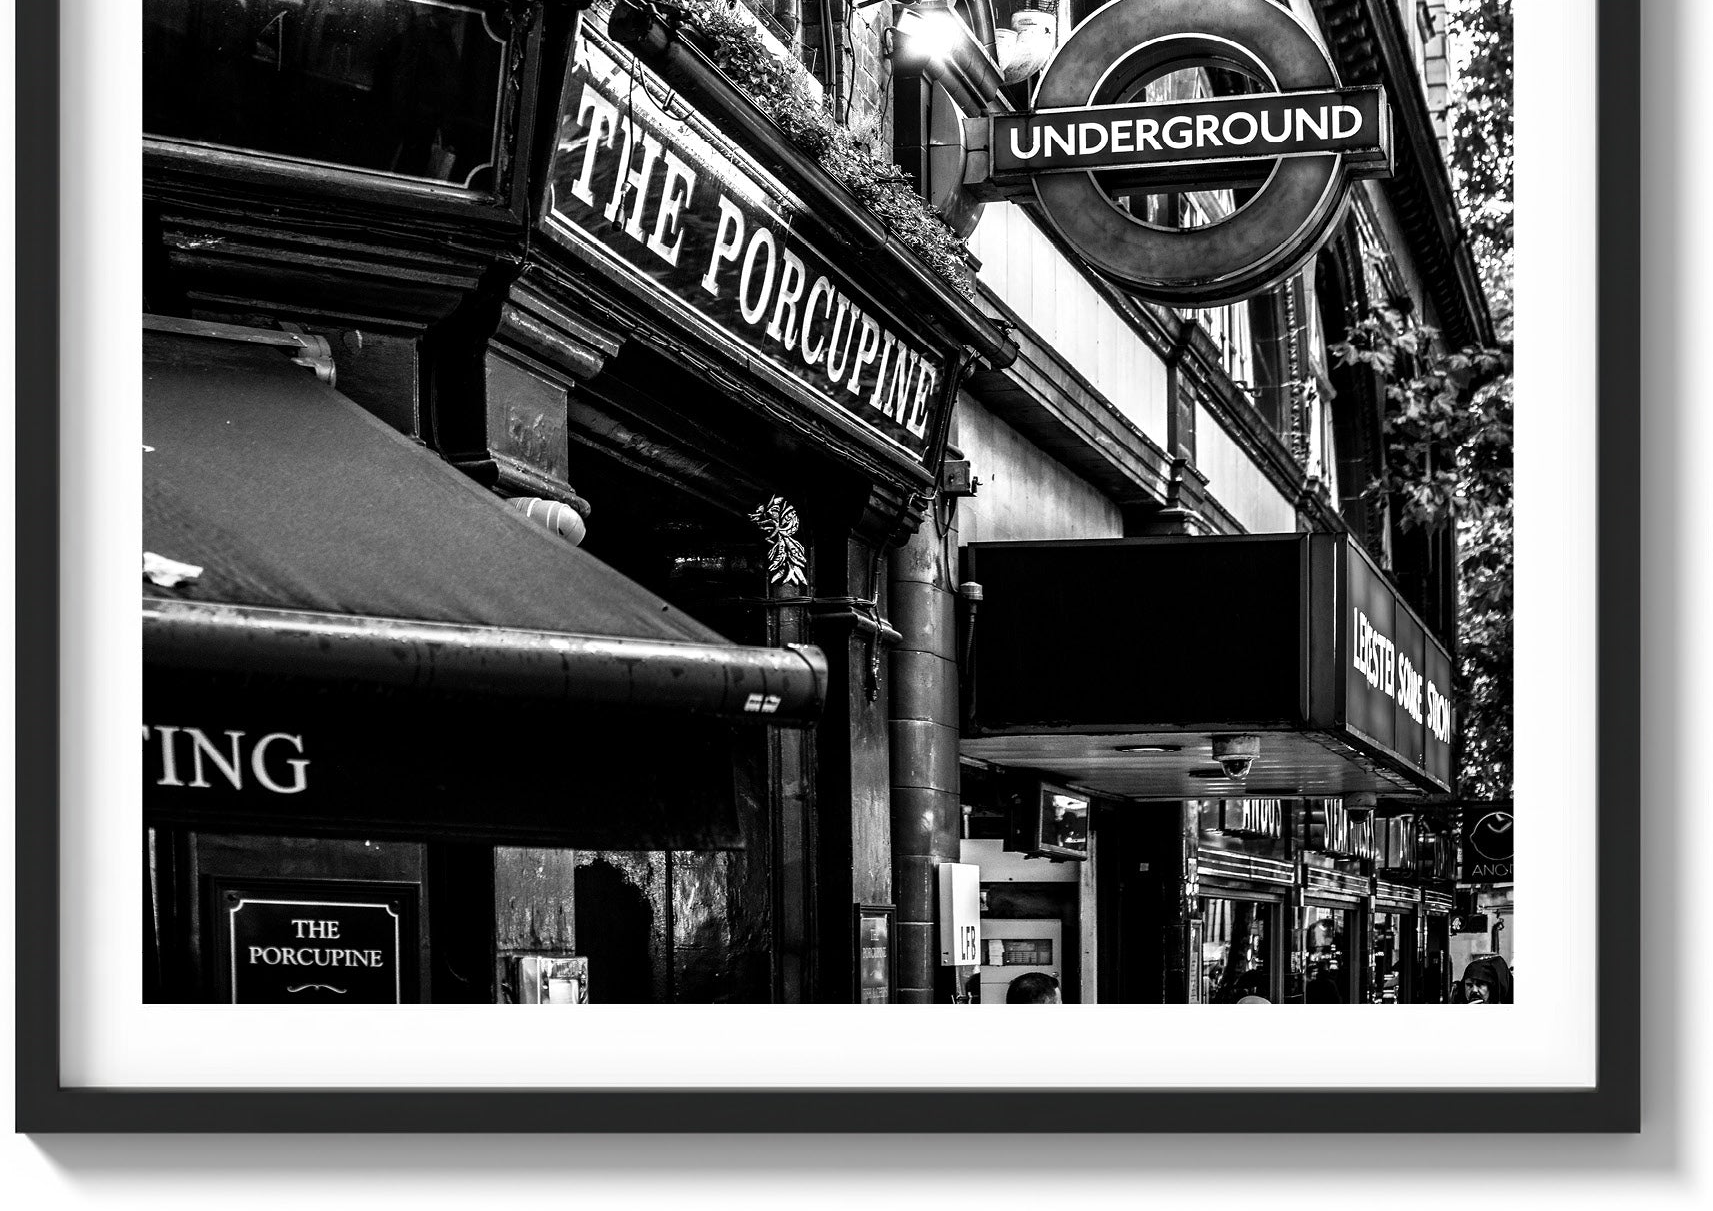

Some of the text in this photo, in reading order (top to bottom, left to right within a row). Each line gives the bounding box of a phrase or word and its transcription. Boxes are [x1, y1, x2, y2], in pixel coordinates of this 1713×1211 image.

[1009, 104, 1363, 160] UNDERGROUND
[571, 83, 938, 440] THE PORCUPINE
[291, 919, 341, 940] THE
[248, 946, 384, 968] PORCUPINE
